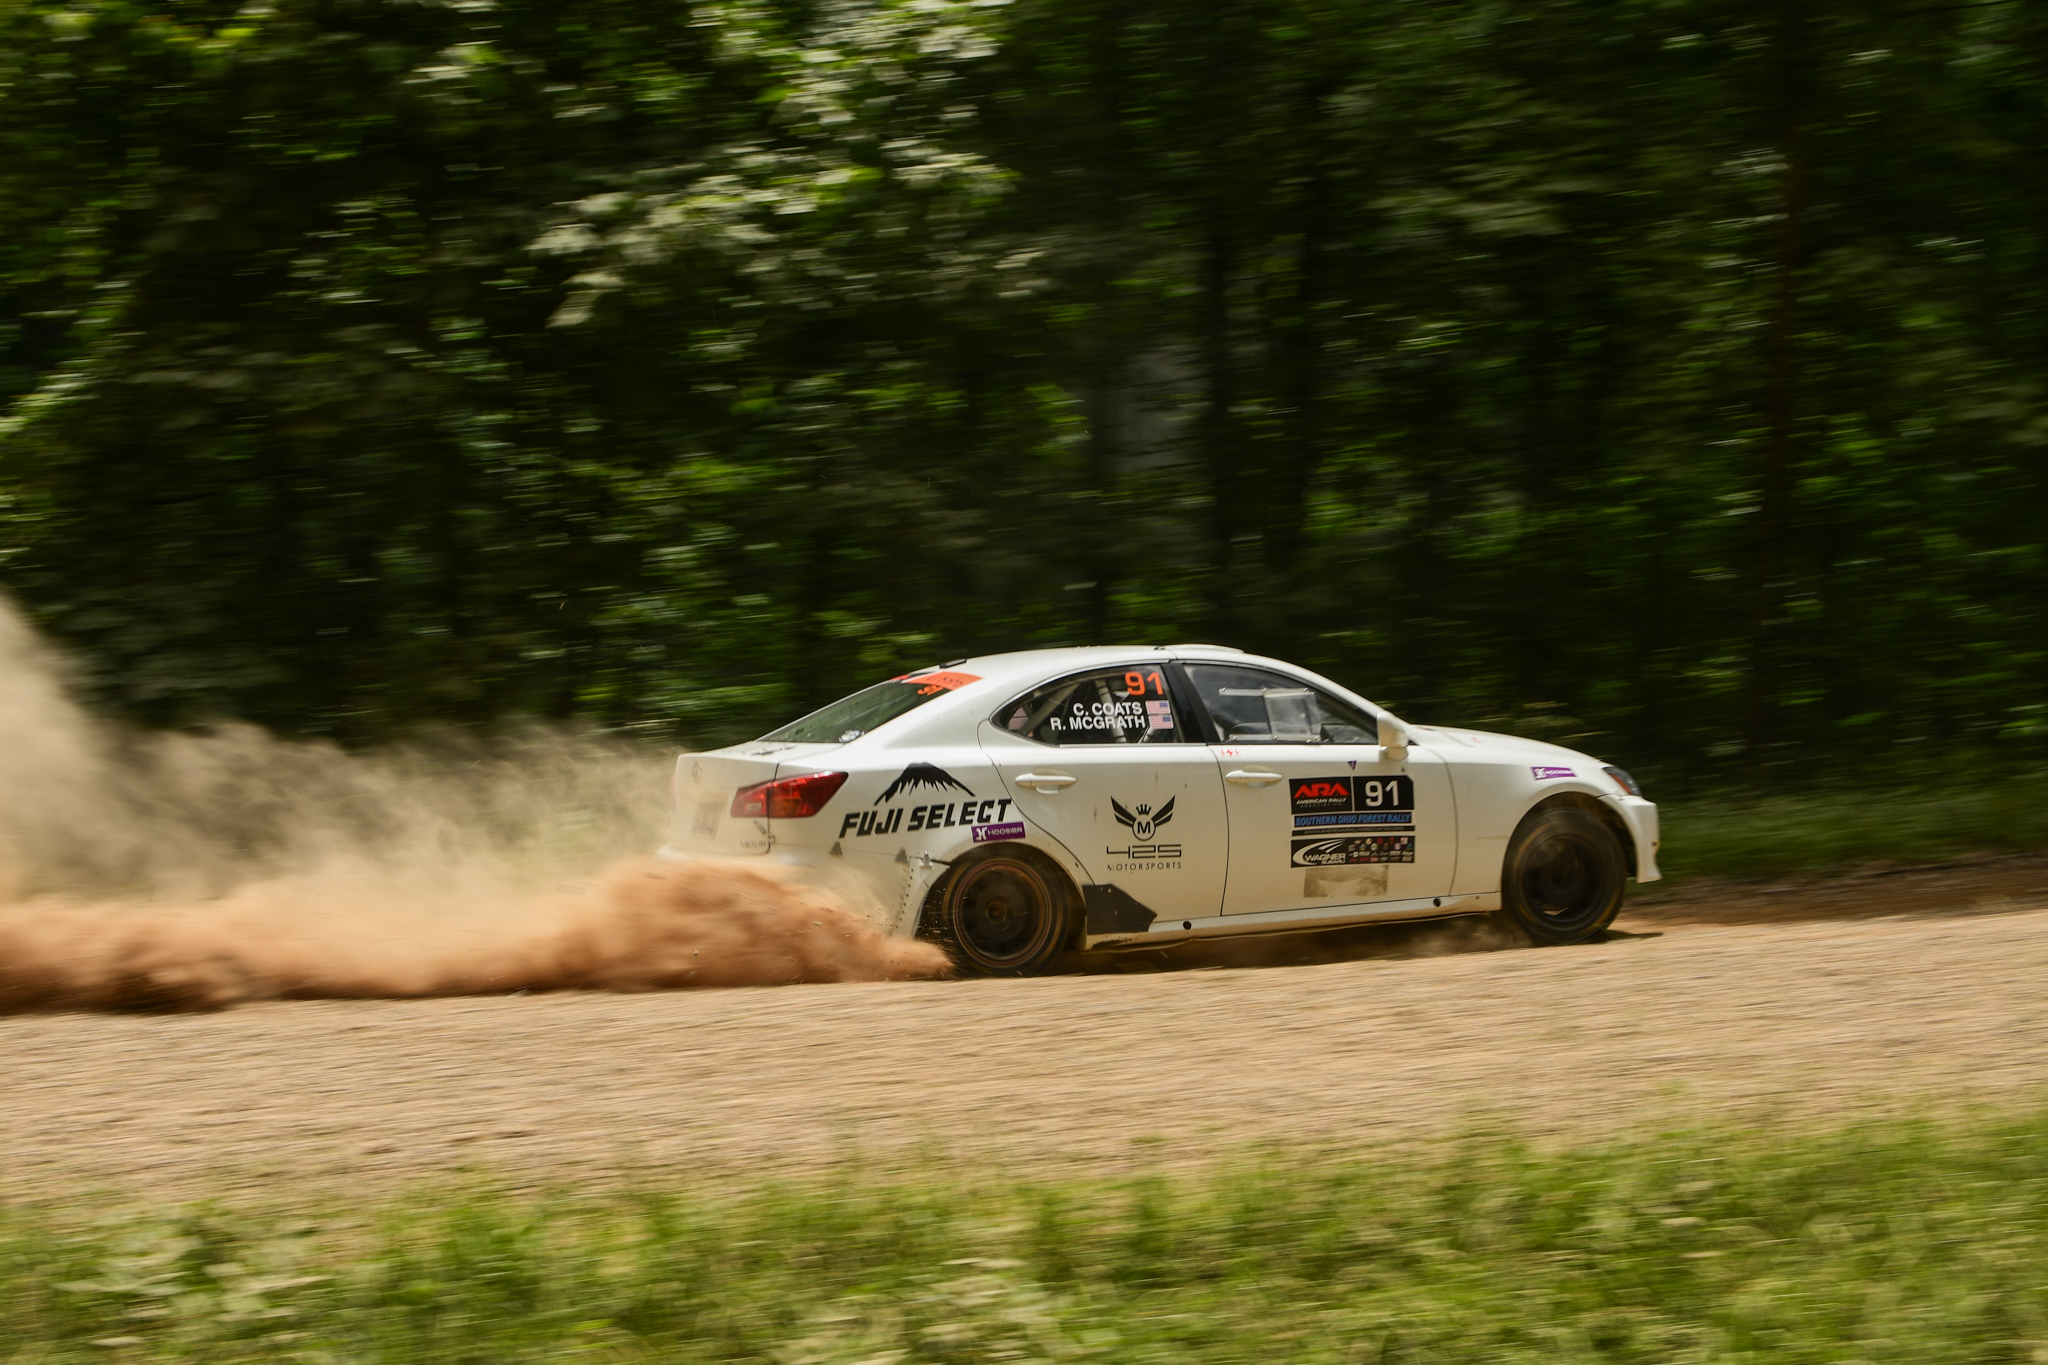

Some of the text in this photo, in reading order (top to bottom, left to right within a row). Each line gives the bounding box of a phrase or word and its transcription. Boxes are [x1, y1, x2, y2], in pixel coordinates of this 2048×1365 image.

[1124, 671, 1164, 696] 91
[1073, 701, 1143, 716] C. COATS
[1050, 716, 1146, 731] R. MCGRATH
[1294, 783, 1349, 798] ARA
[1364, 780, 1399, 807] 91
[839, 798, 1013, 839] FUJI SELECT
[1295, 813, 1411, 827] SOUTHERN OHIO FOREST RALLY
[987, 827, 1023, 836] HOOSIER
[1137, 821, 1151, 834] M
[1106, 844, 1182, 860] 425
[1304, 852, 1346, 862] WAGNER
[1106, 861, 1182, 872] MOTORSPORTS
